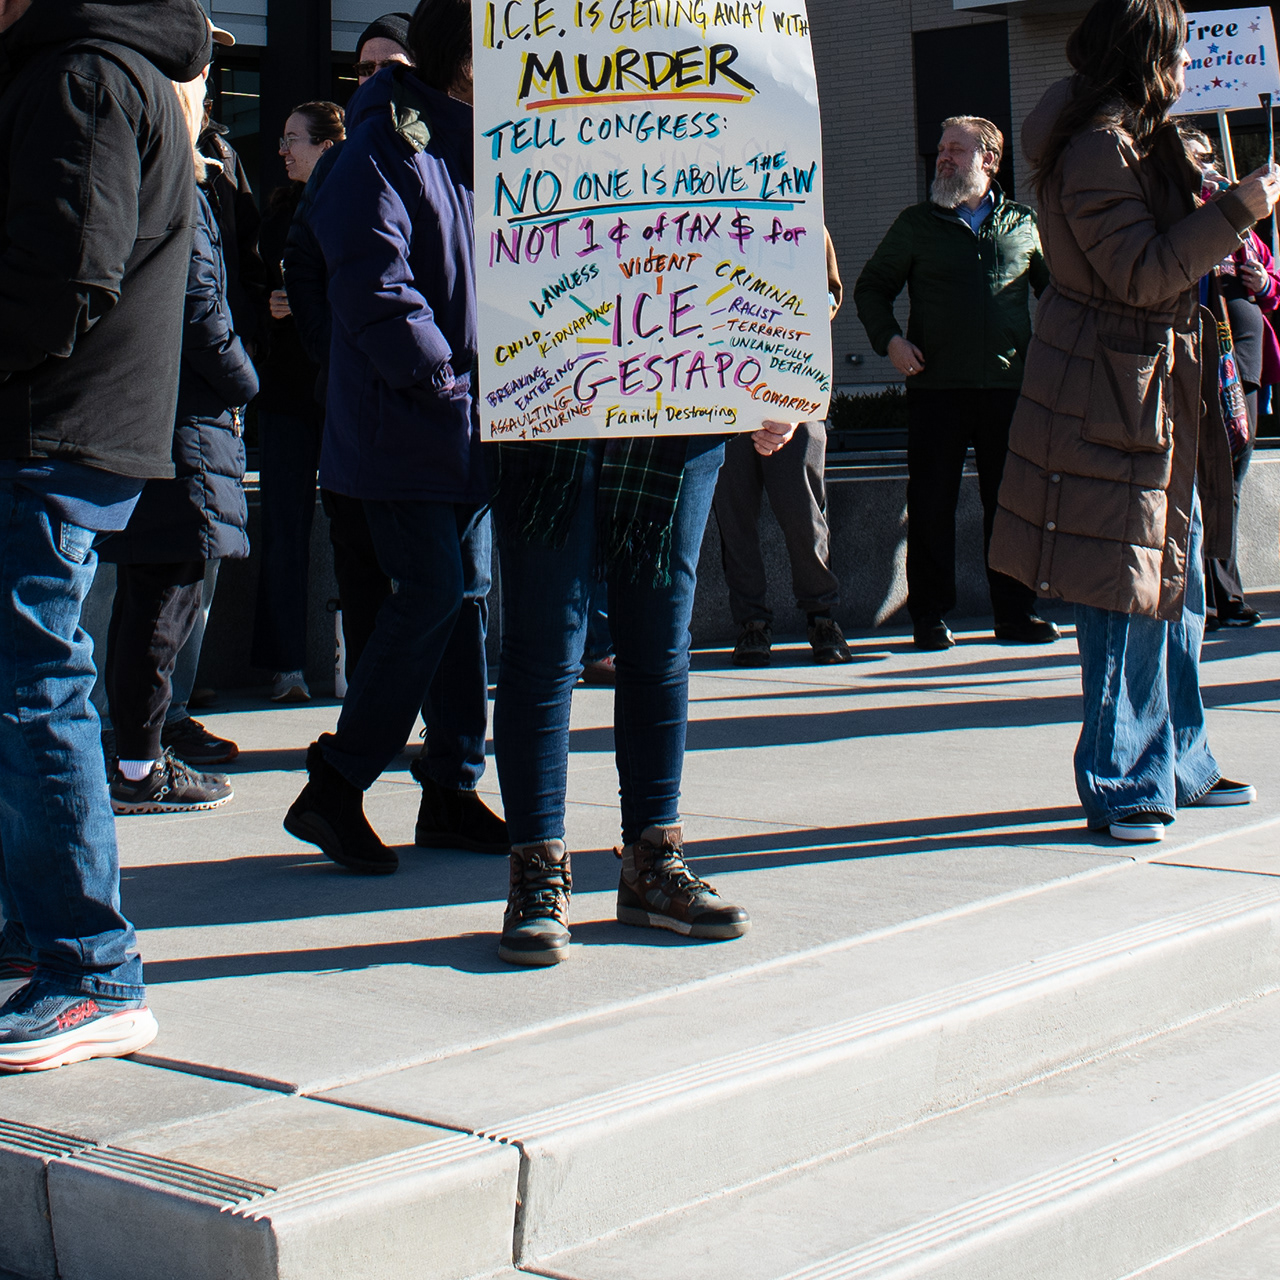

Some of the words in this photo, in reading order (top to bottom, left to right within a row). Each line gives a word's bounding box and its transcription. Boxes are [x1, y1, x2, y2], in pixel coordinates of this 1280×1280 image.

[713, 0, 764, 32] AWAY
[772, 10, 810, 37] WITH
[518, 44, 760, 100] MURDER
[1185, 44, 1267, 70] merica!
[482, 116, 566, 161] TELL
[577, 110, 729, 146] CONGRESS:
[641, 162, 667, 196] IS
[745, 150, 788, 172] THE
[494, 167, 562, 217] NO
[573, 169, 633, 202] ONE
[673, 167, 750, 196] ABOVE
[759, 161, 817, 201] LAW
[489, 217, 571, 268] NOT
[642, 212, 669, 242] of
[671, 211, 722, 246] TAX
[727, 206, 755, 254] $
[762, 218, 807, 248] for
[528, 262, 600, 319] LAWLESS
[714, 258, 808, 317] CRIMINAL
[613, 283, 705, 348] I.C.E.
[728, 296, 783, 323] RACIST
[537, 300, 616, 359] KIDNAPPING
[726, 318, 812, 342] TERRORIST
[729, 336, 814, 364] UNLAWFULLY
[513, 357, 580, 412] ENTERING
[573, 349, 762, 406] GESTAPO
[769, 356, 831, 393] DETAINING
[489, 395, 573, 438] ASSAULTING
[605, 404, 659, 429] Family
[665, 405, 738, 426] Destroying
[750, 382, 822, 416] COWARDLY
[531, 402, 594, 438] INJURING
[55, 999, 100, 1031] HOKA
